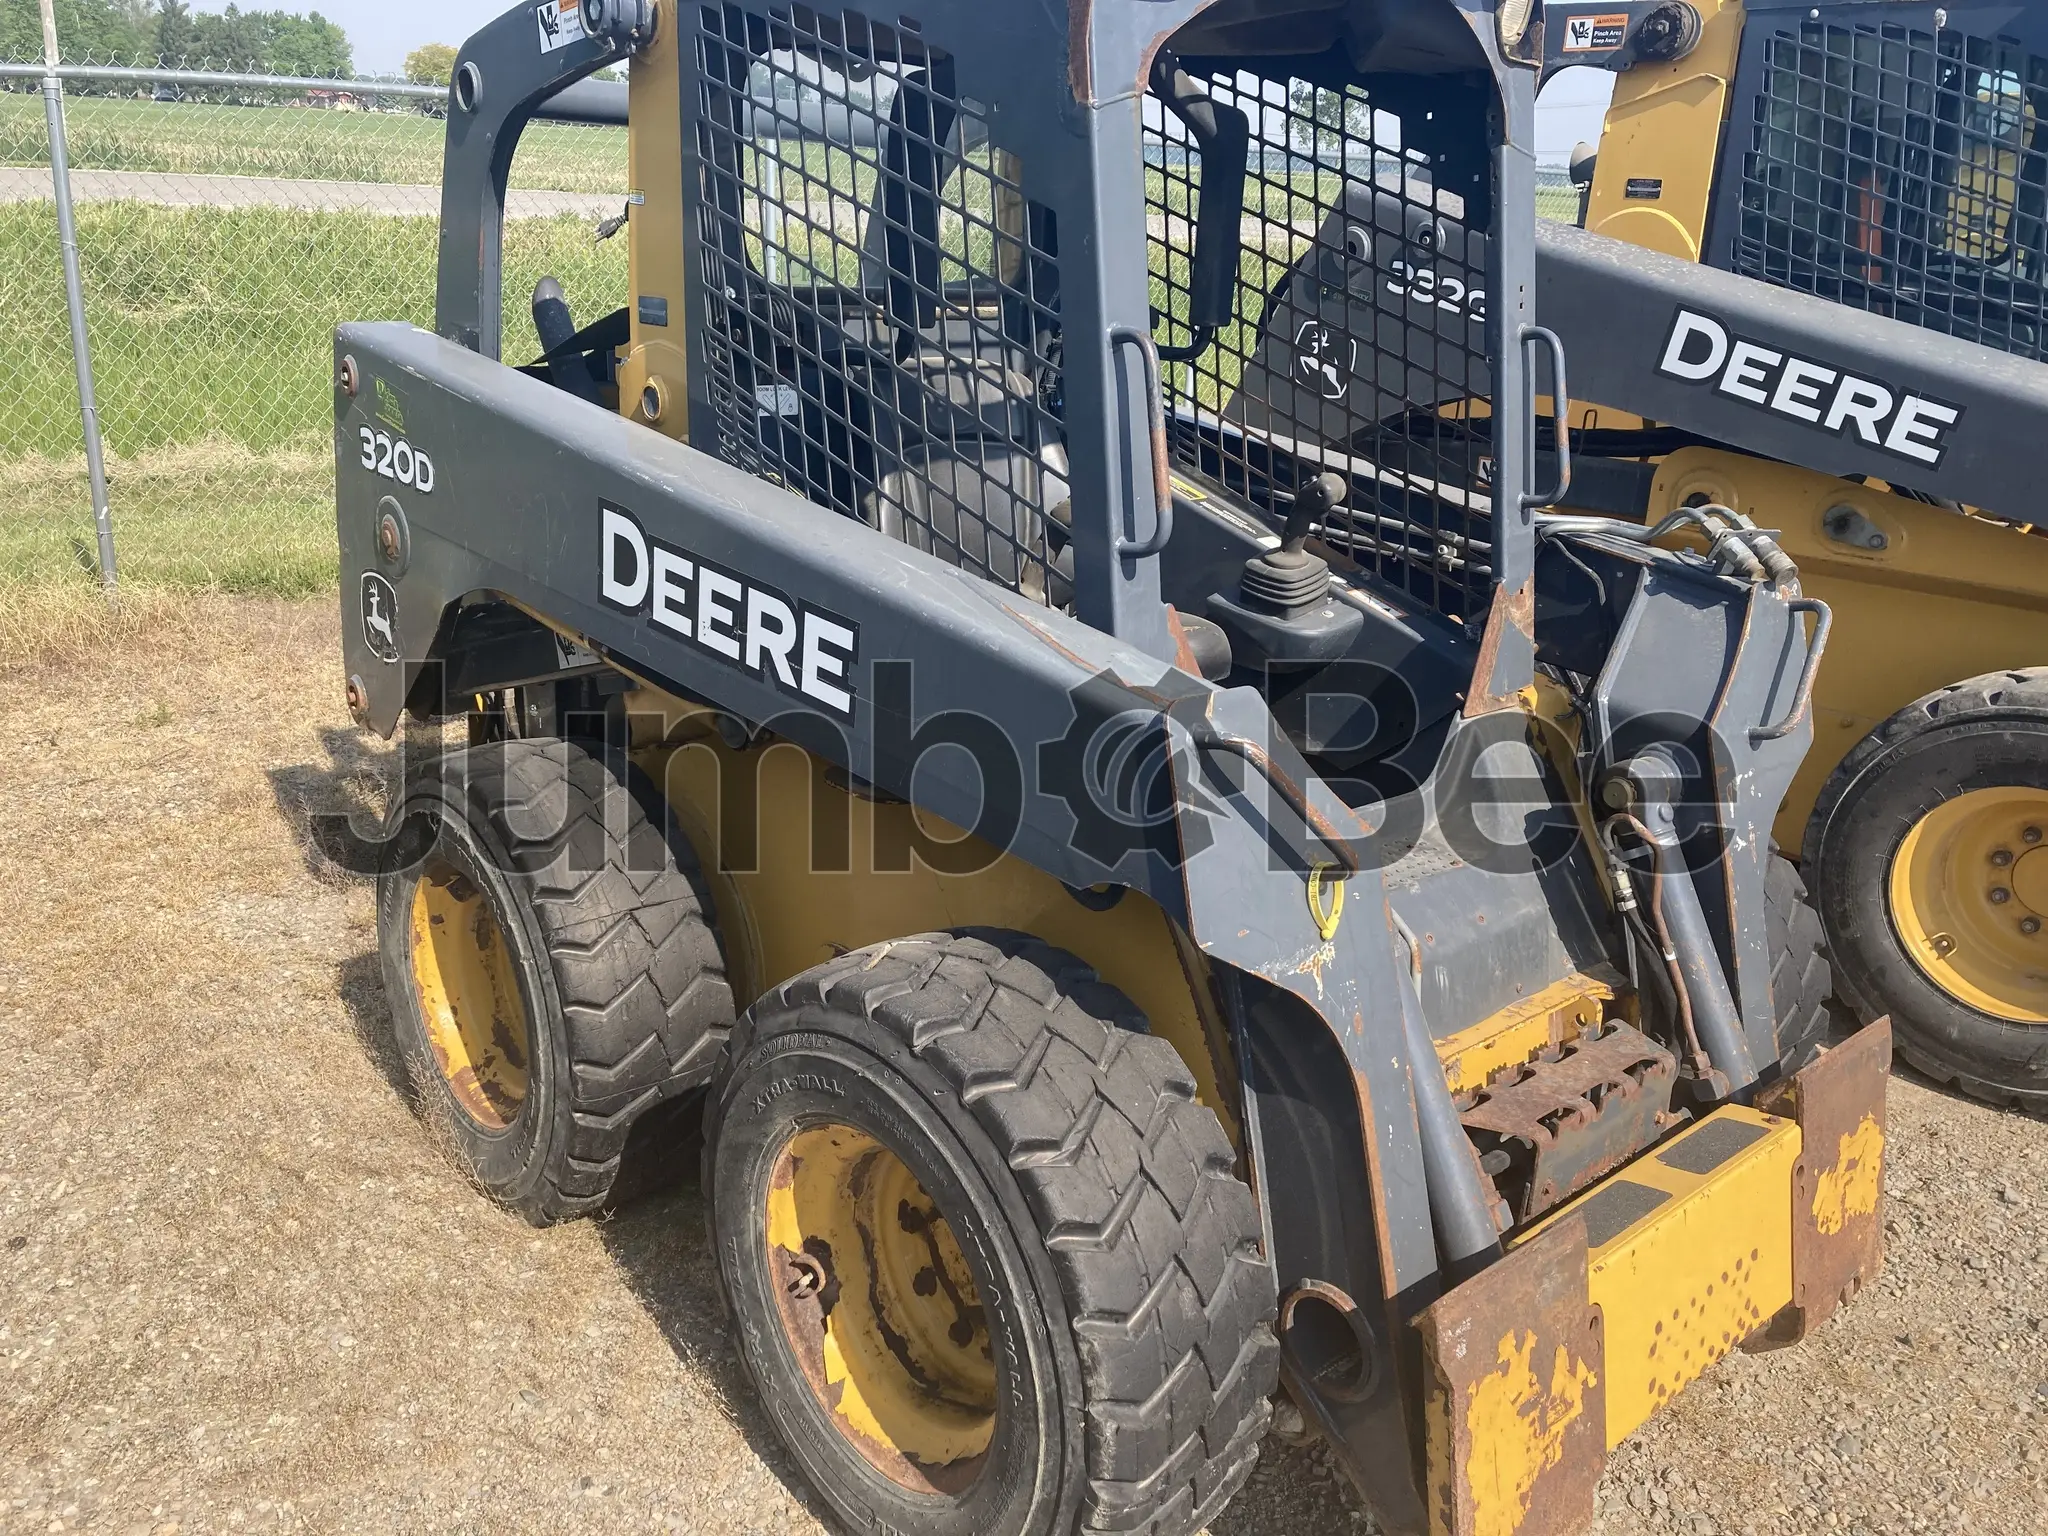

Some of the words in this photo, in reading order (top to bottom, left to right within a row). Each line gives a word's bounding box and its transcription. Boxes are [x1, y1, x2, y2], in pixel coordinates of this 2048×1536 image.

[359, 426, 434, 493] 320D
[1660, 309, 1959, 464] DEERE
[602, 507, 855, 714] DEERE
